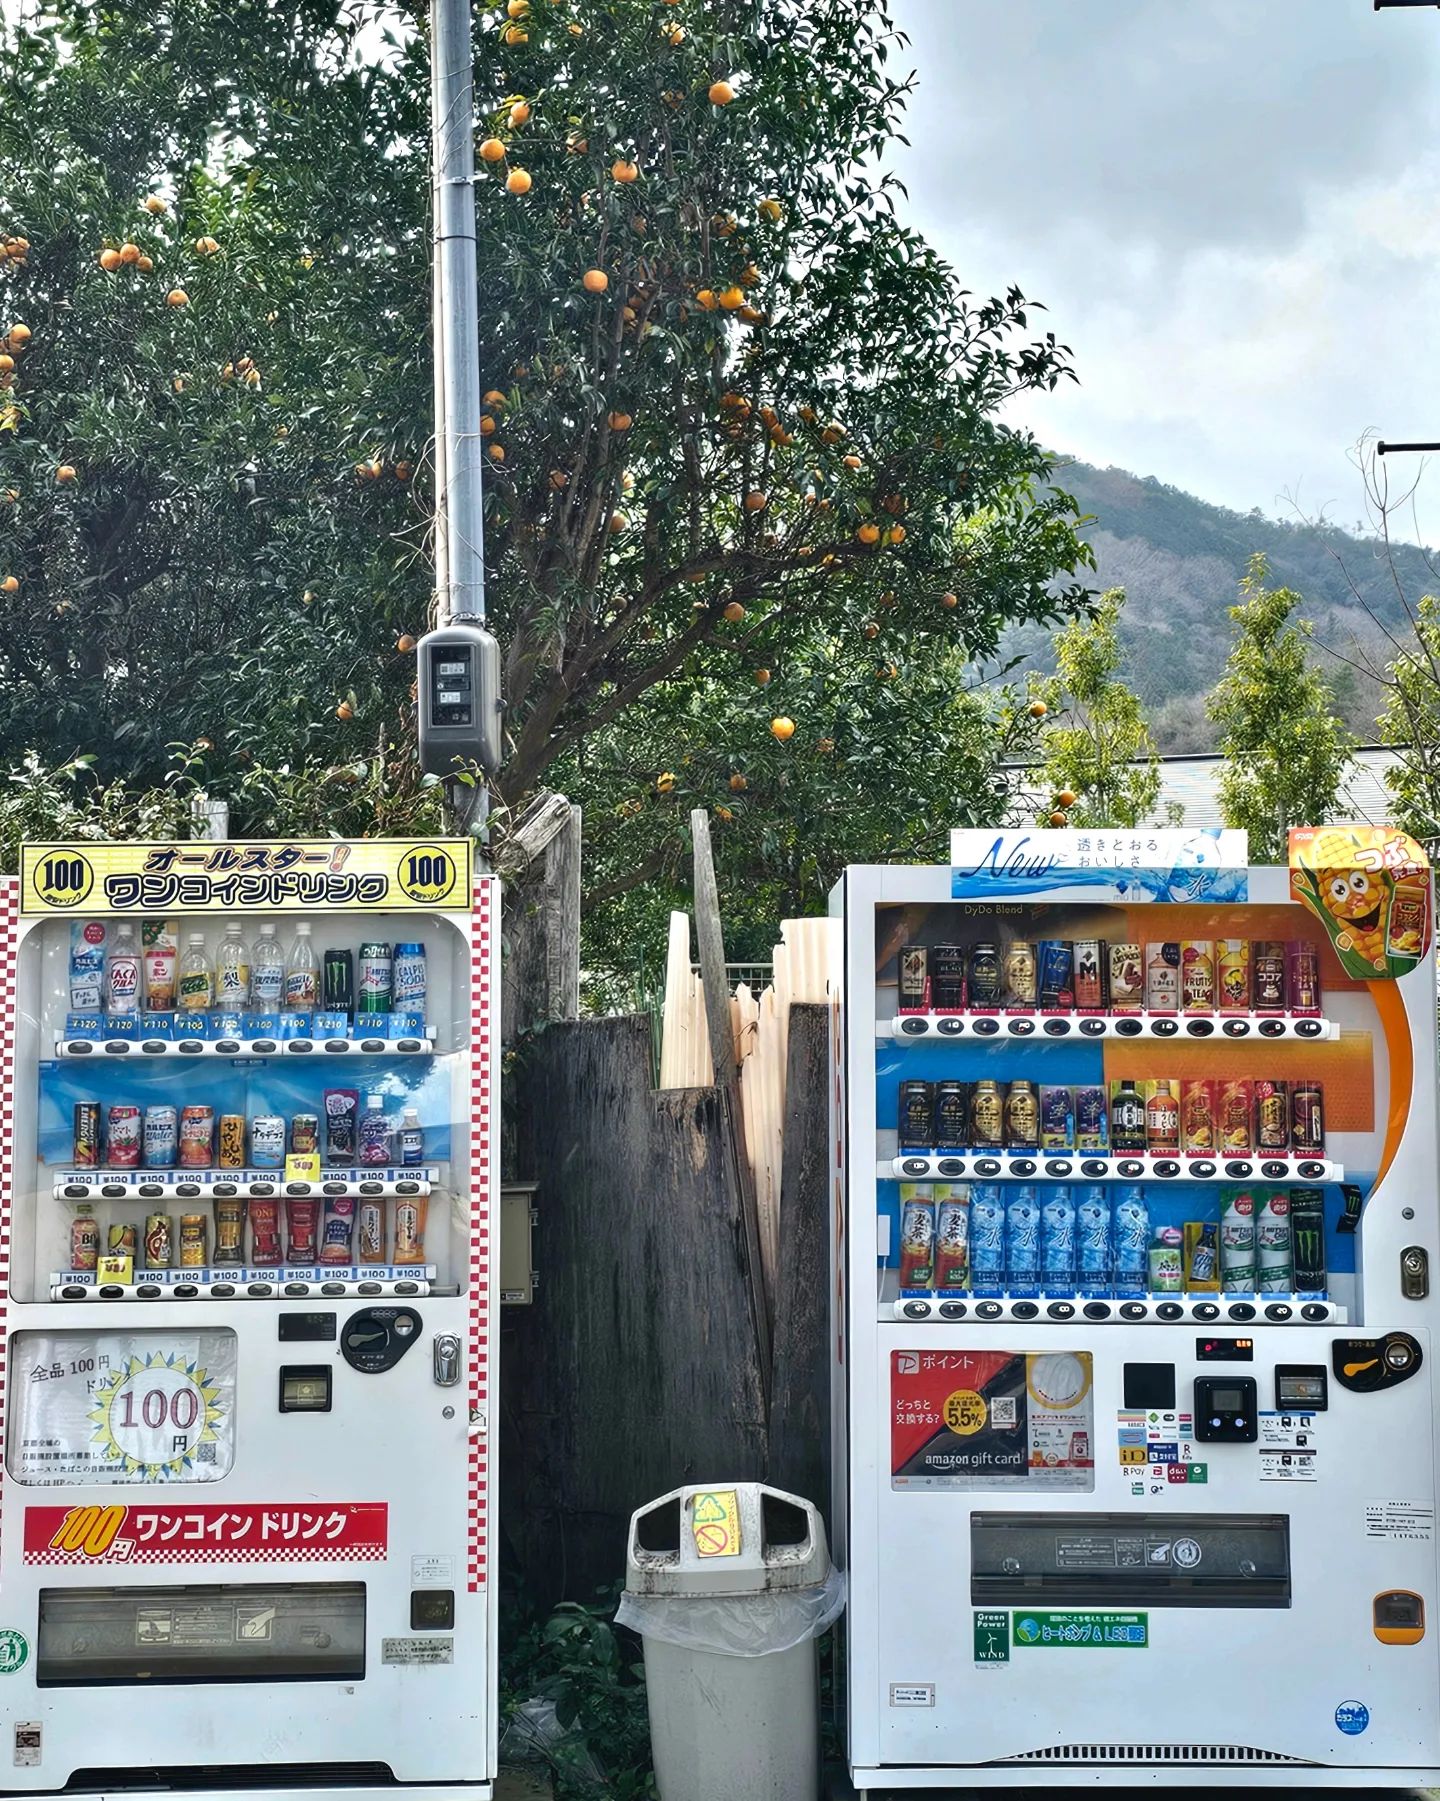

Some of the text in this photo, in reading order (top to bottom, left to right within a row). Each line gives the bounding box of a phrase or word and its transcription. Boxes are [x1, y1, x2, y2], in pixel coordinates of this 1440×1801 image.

[1077, 838, 1159, 852] 透きとおる
[959, 836, 1056, 878] New
[1078, 855, 1141, 868] おいしさ
[1354, 836, 1410, 874] つぶ
[42, 858, 84, 891] 100
[407, 854, 448, 887] 100
[104, 873, 388, 909] ワンコインドリンク
[1188, 875, 1212, 897] 水
[964, 903, 1023, 916] DyDo Blend
[1185, 977, 1213, 987] FRUITS
[1258, 973, 1281, 982] ココア
[911, 1213, 926, 1239] 麦茶
[946, 1213, 961, 1239] 麦茶
[65, 1275, 91, 1283] ¥100
[138, 1273, 163, 1281] ¥100
[174, 1272, 199, 1280] ¥100
[213, 1272, 238, 1280] ¥100
[250, 1271, 275, 1280] ¥100
[287, 1271, 312, 1279] ¥100
[324, 1270, 349, 1278] ¥100
[361, 1270, 386, 1278] ¥100
[396, 1269, 421, 1278] ¥100
[30, 1355, 110, 1383] 全品 100 円
[923, 1356, 974, 1369] ポイント
[119, 1388, 199, 1429] 100
[896, 1400, 931, 1411] どっちと
[896, 1413, 940, 1425] 交換する?
[948, 1408, 982, 1426] 5.5%
[172, 1435, 188, 1452] 円
[925, 1452, 1021, 1467] amazon gift card
[1122, 1449, 1146, 1462] iD
[136, 1512, 254, 1542] ワンコイン
[261, 1511, 348, 1540] ドリンク
[977, 1613, 1005, 1621] Green
[977, 1620, 1006, 1628] Power
[978, 1651, 1005, 1659] WIND
